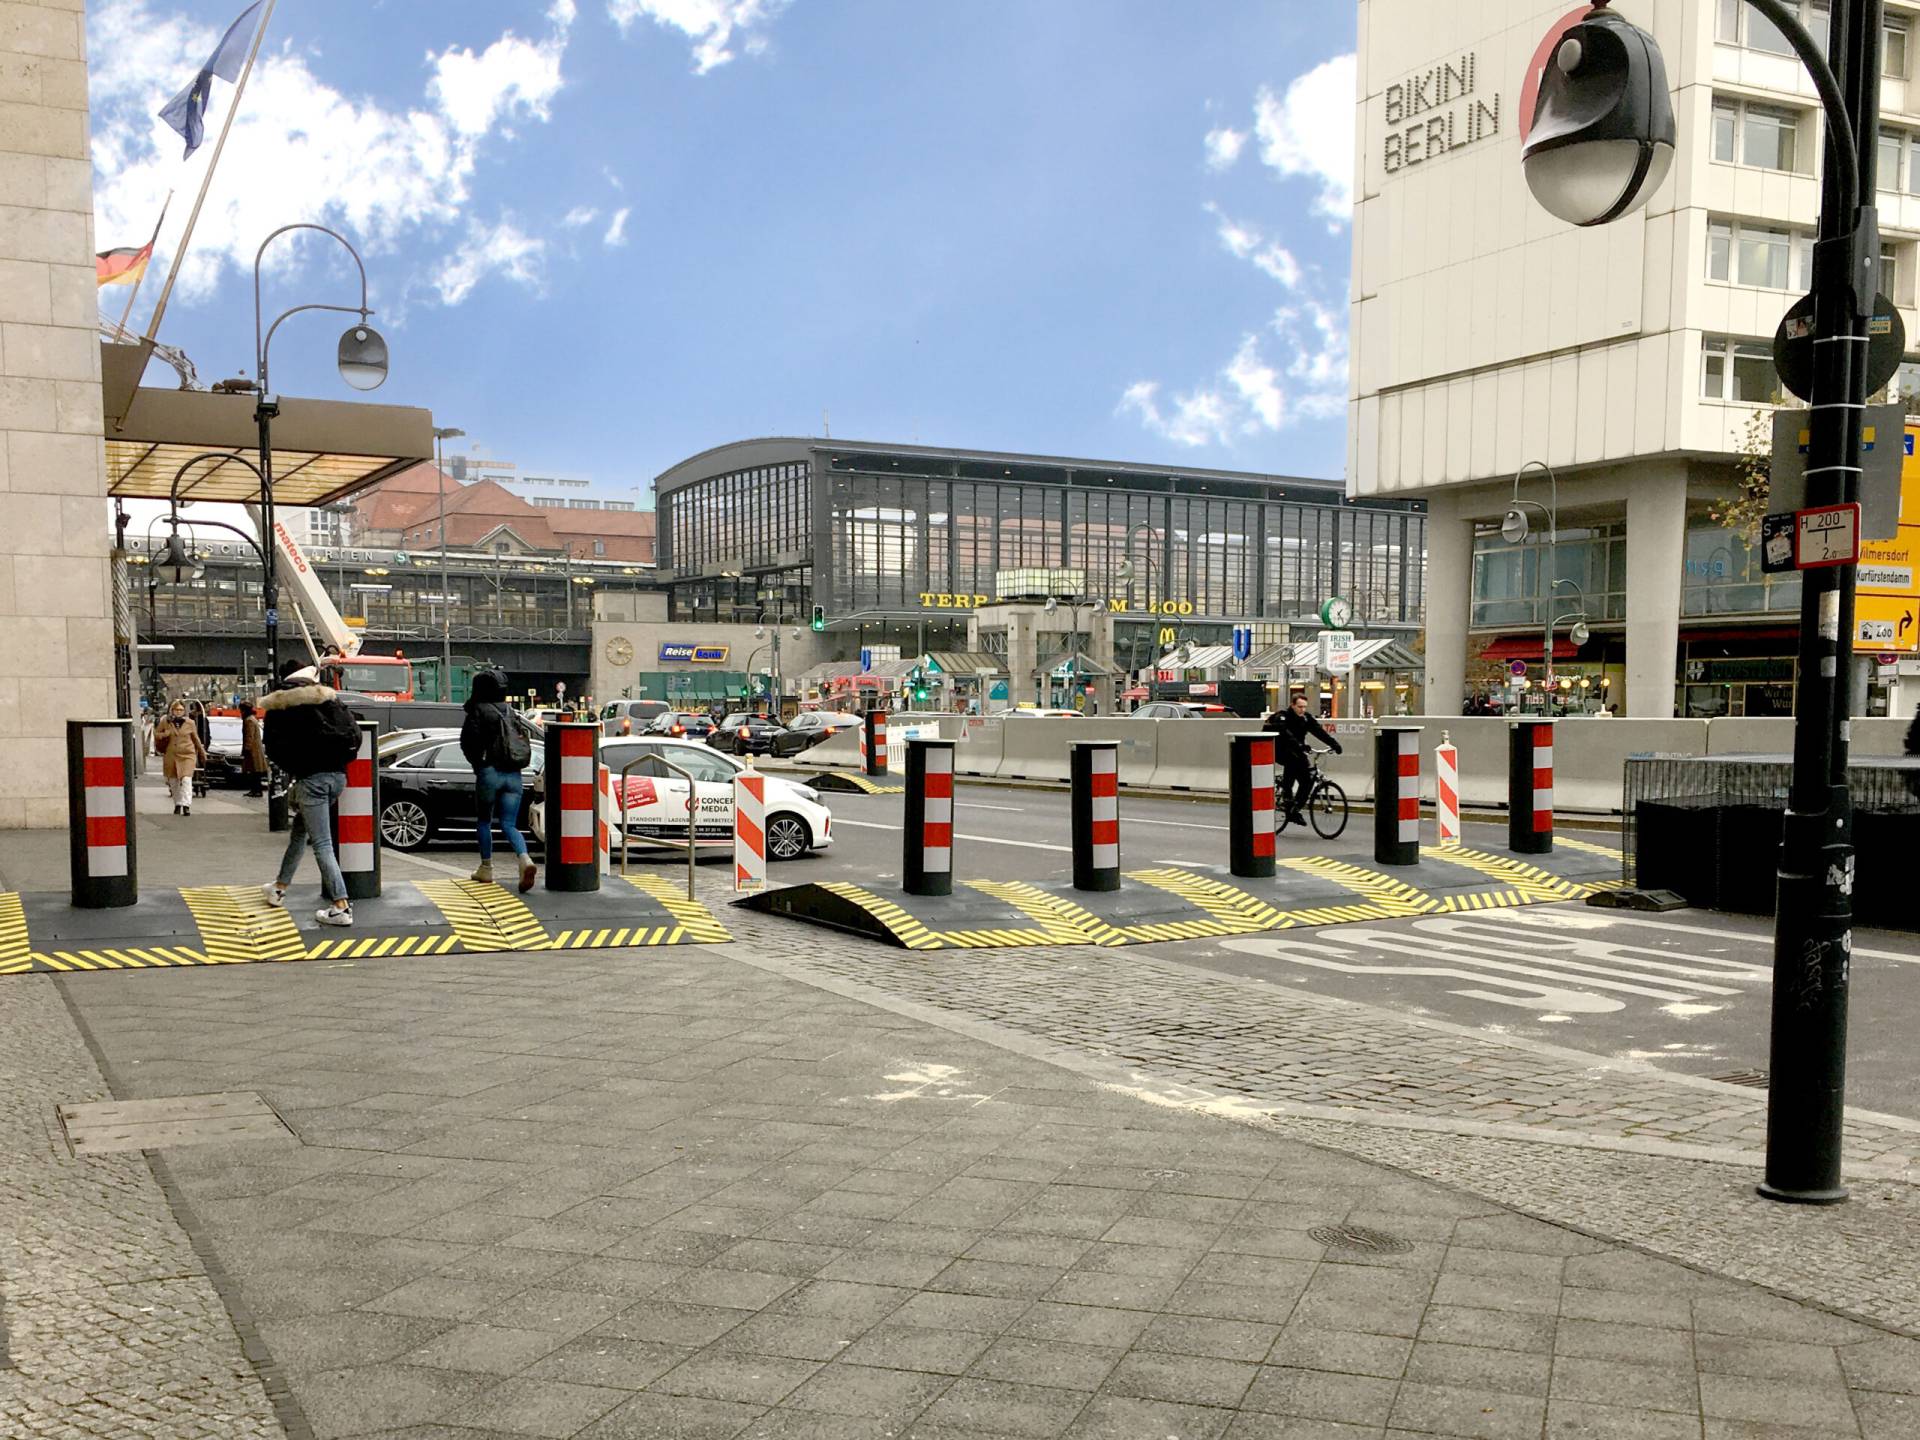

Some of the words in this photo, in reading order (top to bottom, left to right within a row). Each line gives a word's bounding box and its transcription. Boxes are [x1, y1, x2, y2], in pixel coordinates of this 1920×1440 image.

[1385, 51, 1475, 126] BIKINI
[1384, 92, 1500, 174] BERLIN
[1800, 517, 1808, 529] H
[1817, 512, 1840, 528] 200
[1763, 523, 1772, 536] S
[273, 522, 307, 573] mateco
[1856, 570, 1910, 584] Kurfürstendamm
[665, 647, 693, 657] Reise
[374, 694, 397, 702] teco
[701, 797, 734, 805] CONCEP
[701, 805, 729, 813] MEDIA
